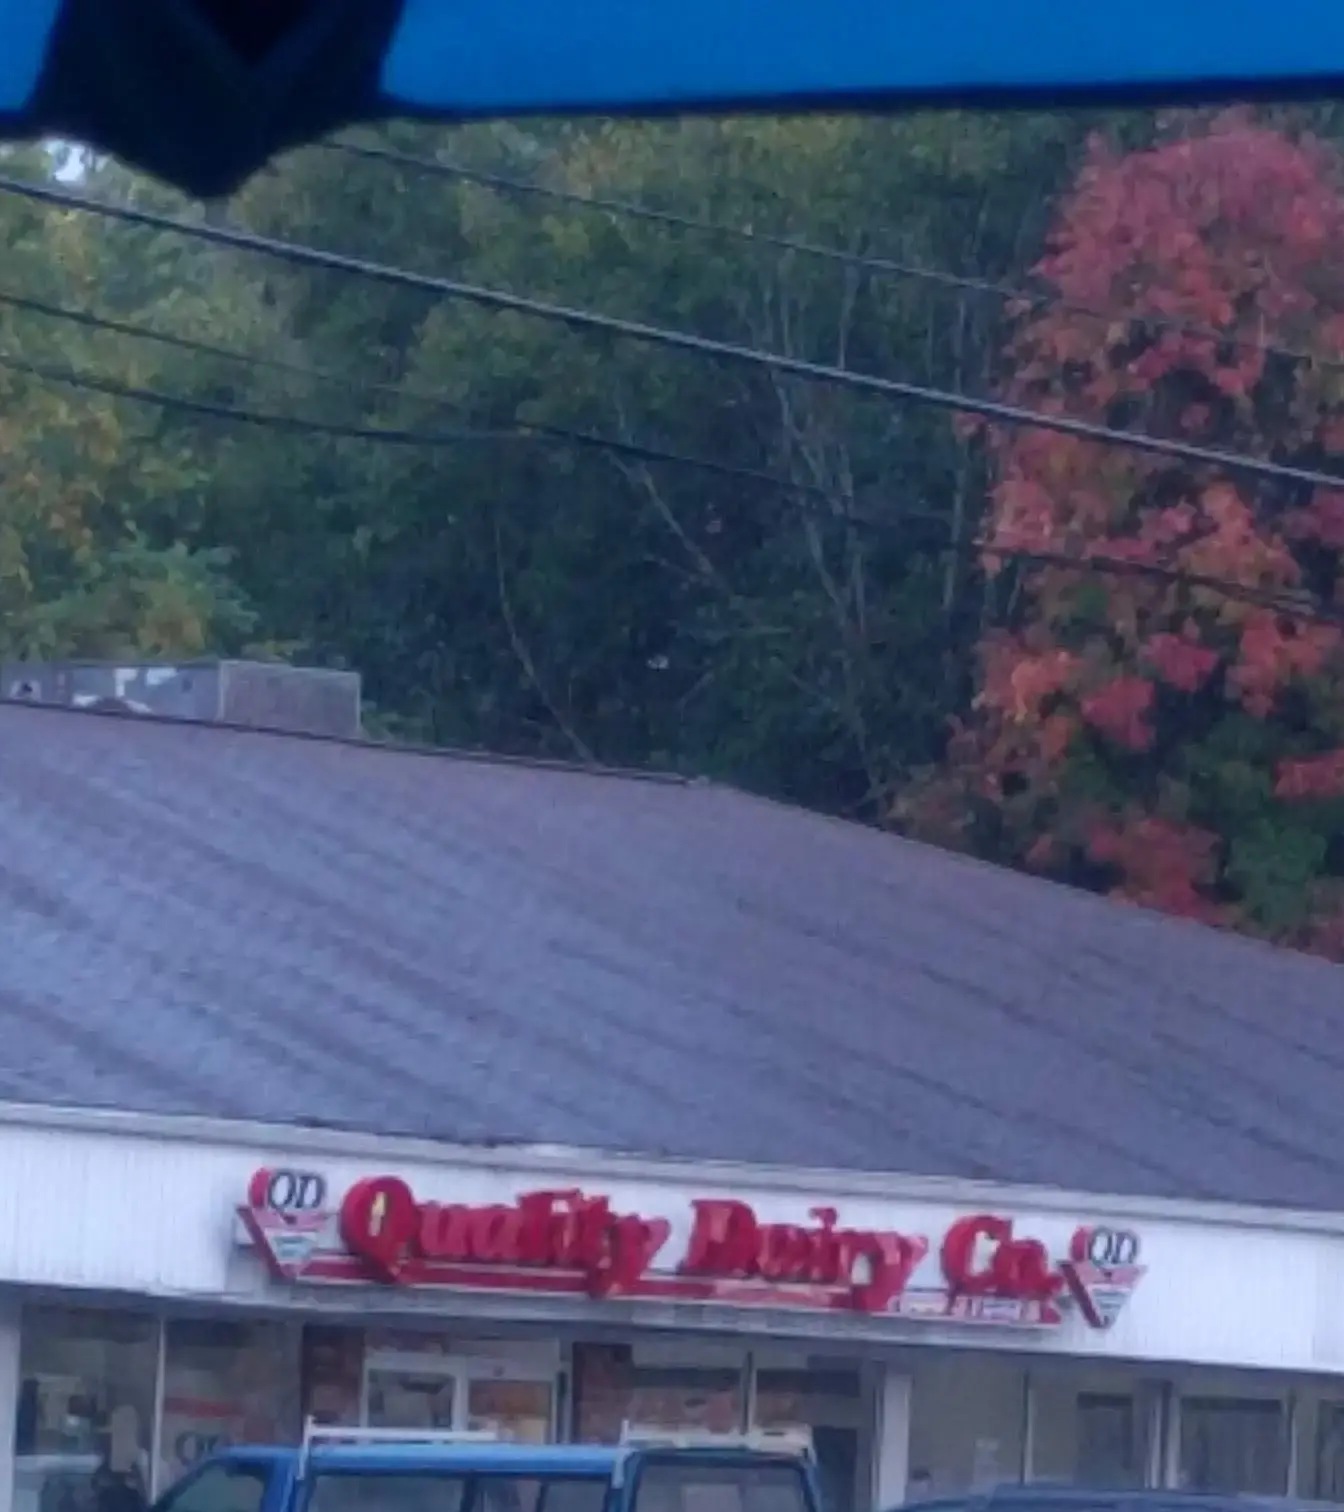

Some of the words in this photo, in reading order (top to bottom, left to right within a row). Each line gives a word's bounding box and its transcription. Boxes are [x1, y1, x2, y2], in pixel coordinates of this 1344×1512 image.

[256, 1167, 326, 1222] QD
[341, 1176, 670, 1298] Quality
[678, 1199, 928, 1312] Dairy
